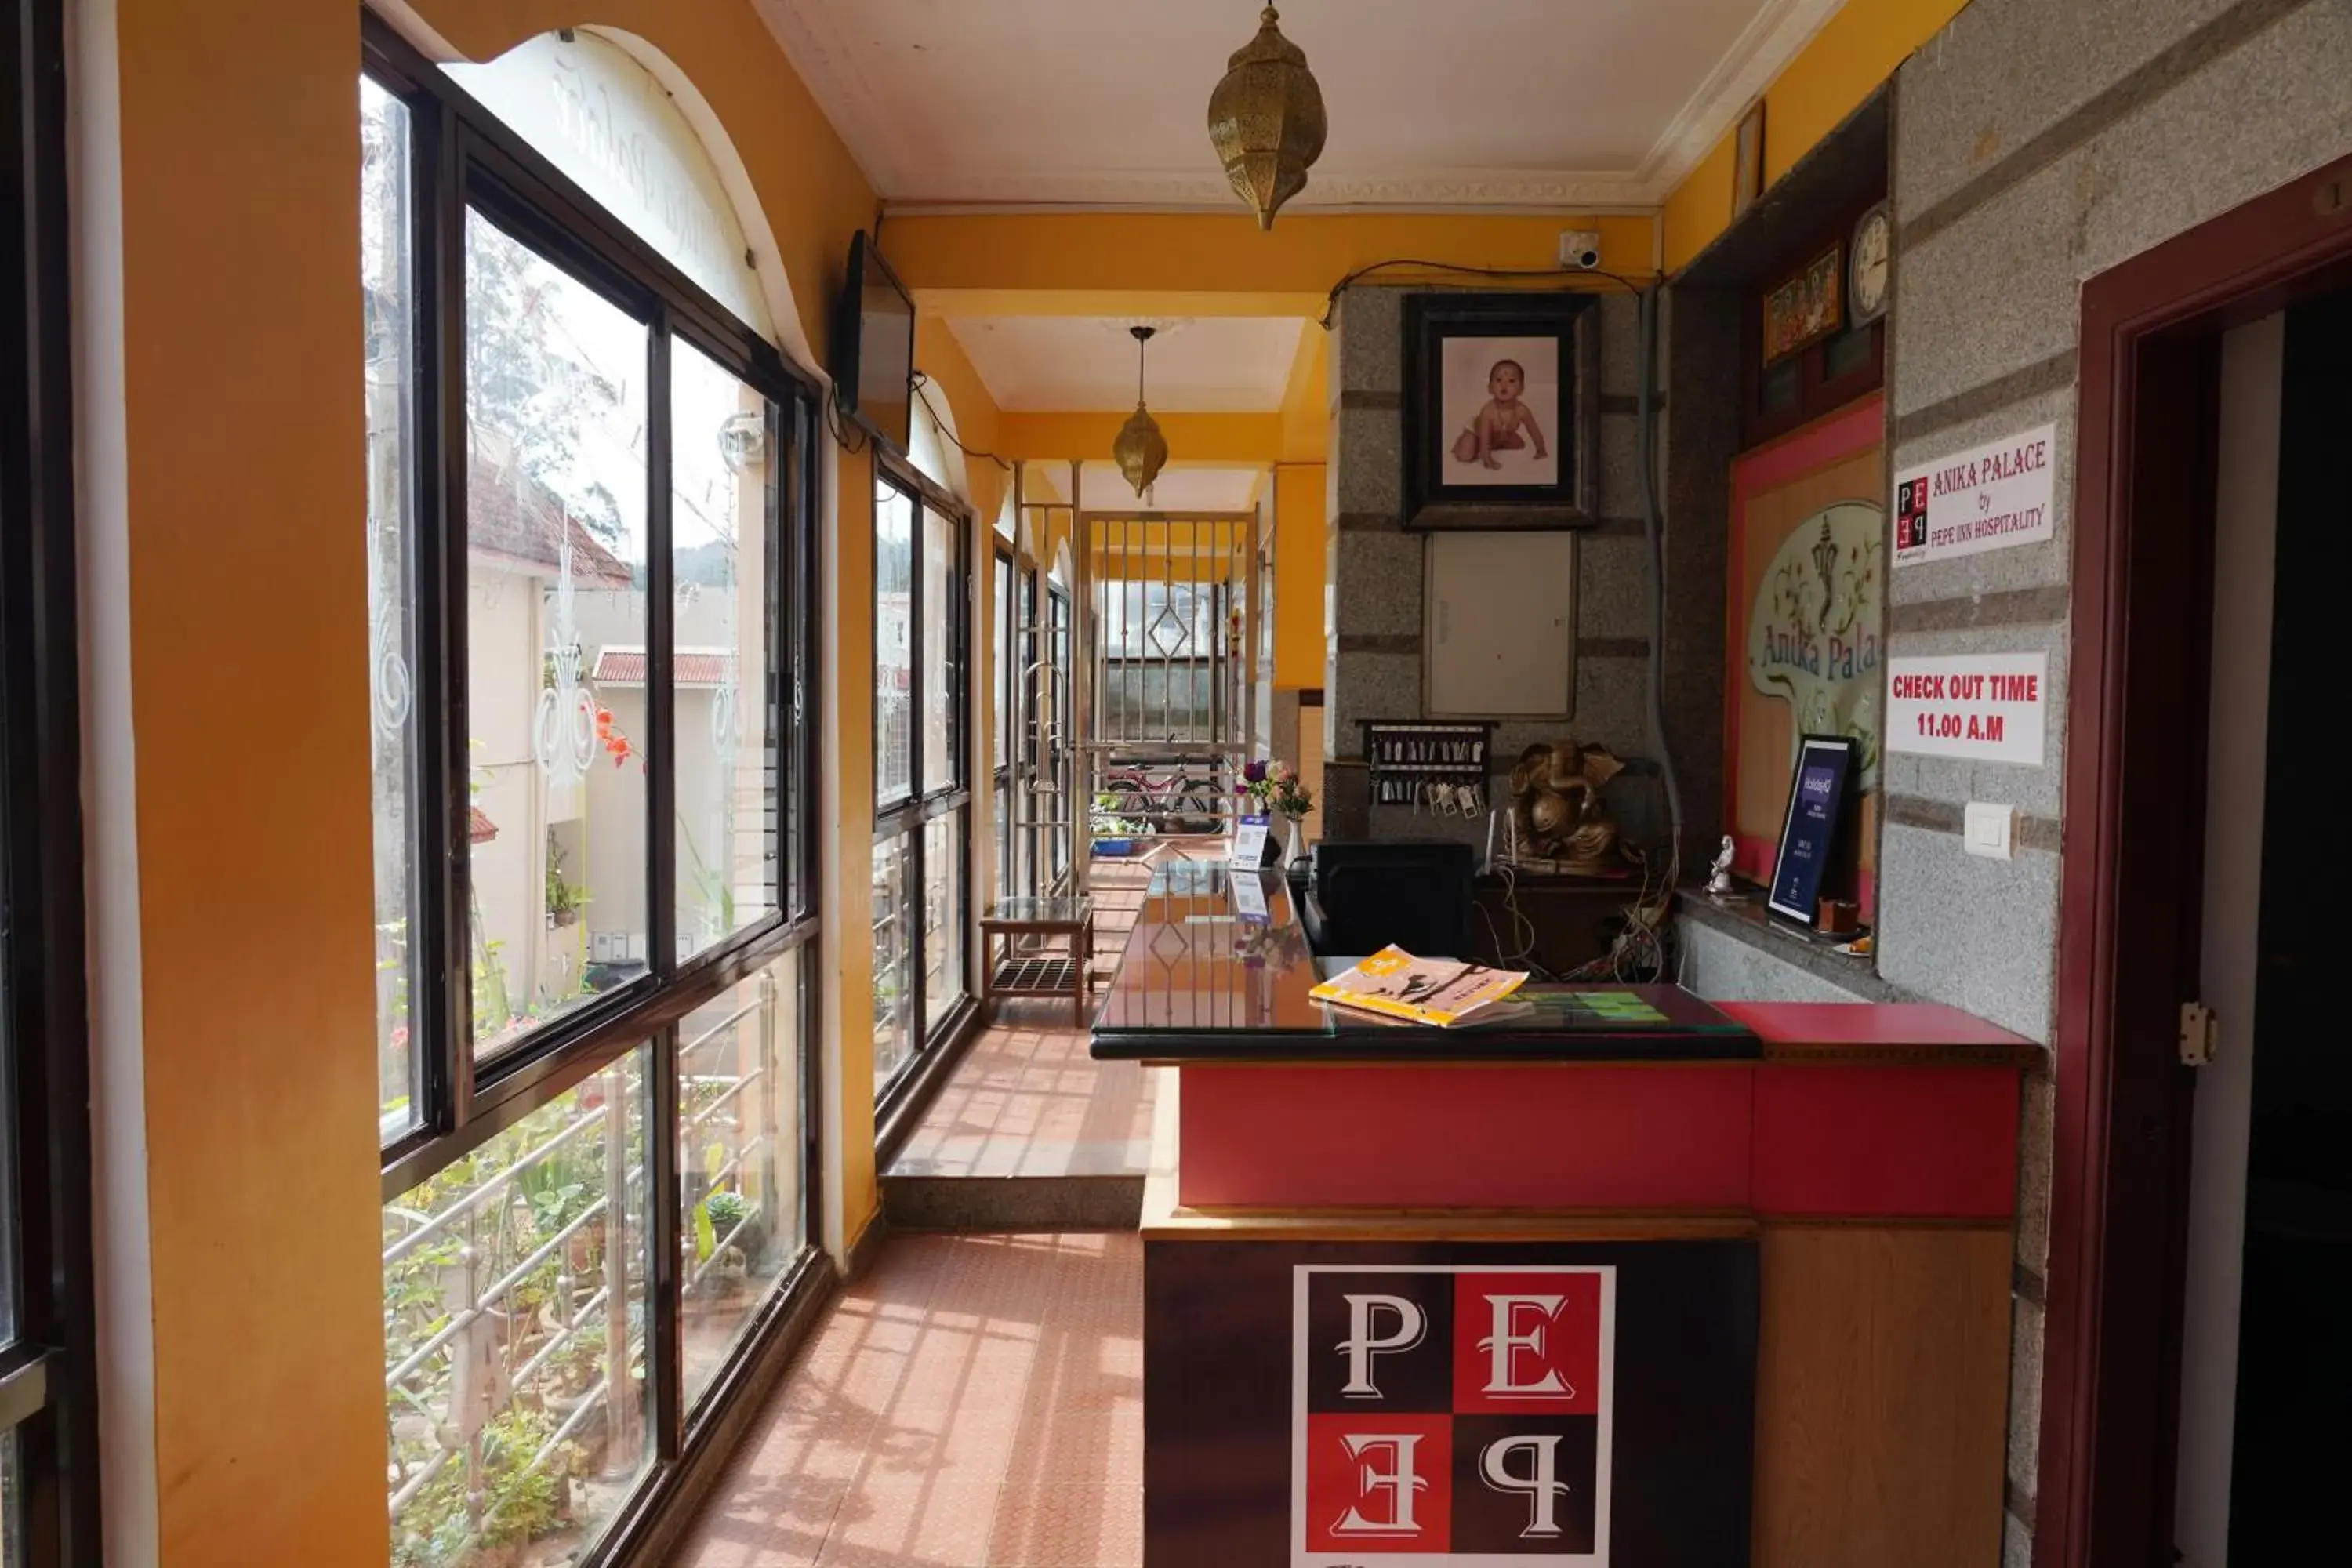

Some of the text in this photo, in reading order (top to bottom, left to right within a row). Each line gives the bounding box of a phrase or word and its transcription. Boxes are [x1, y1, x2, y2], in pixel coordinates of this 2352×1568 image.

[1933, 441, 2045, 497] ANIKA PALACE
[1979, 491, 1991, 514] by
[1931, 503, 2045, 548] PEPE INN HOSPITALITY
[1828, 622, 1882, 681] Pala
[1893, 674, 2038, 701] CHECK OUT TIME
[1918, 713, 2004, 741] 11.00 A.M
